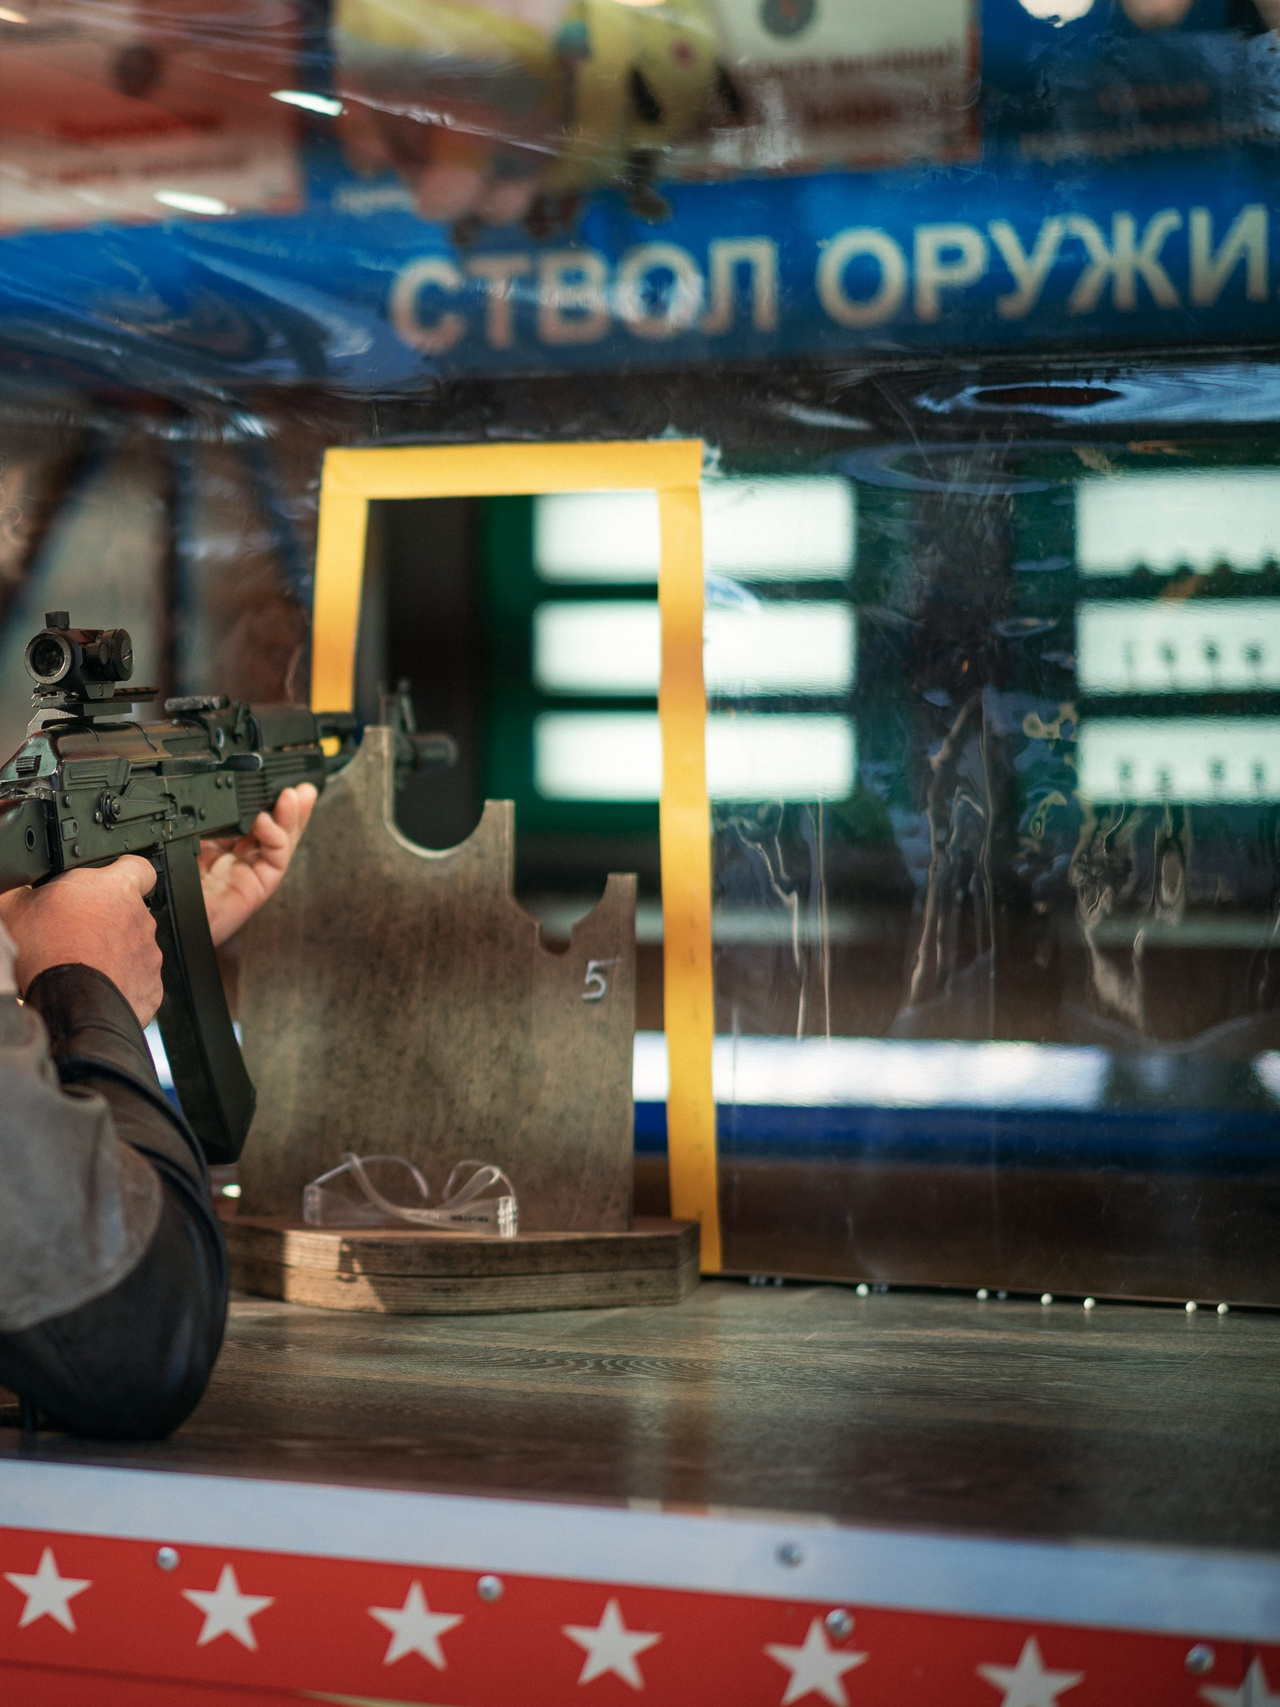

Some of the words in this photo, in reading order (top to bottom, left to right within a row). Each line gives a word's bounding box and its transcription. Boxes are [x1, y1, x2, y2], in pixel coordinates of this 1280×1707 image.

[391, 236, 778, 353] СТВОЛ
[816, 203, 1269, 328] ОРУЖИ
[581, 959, 620, 999] 5
